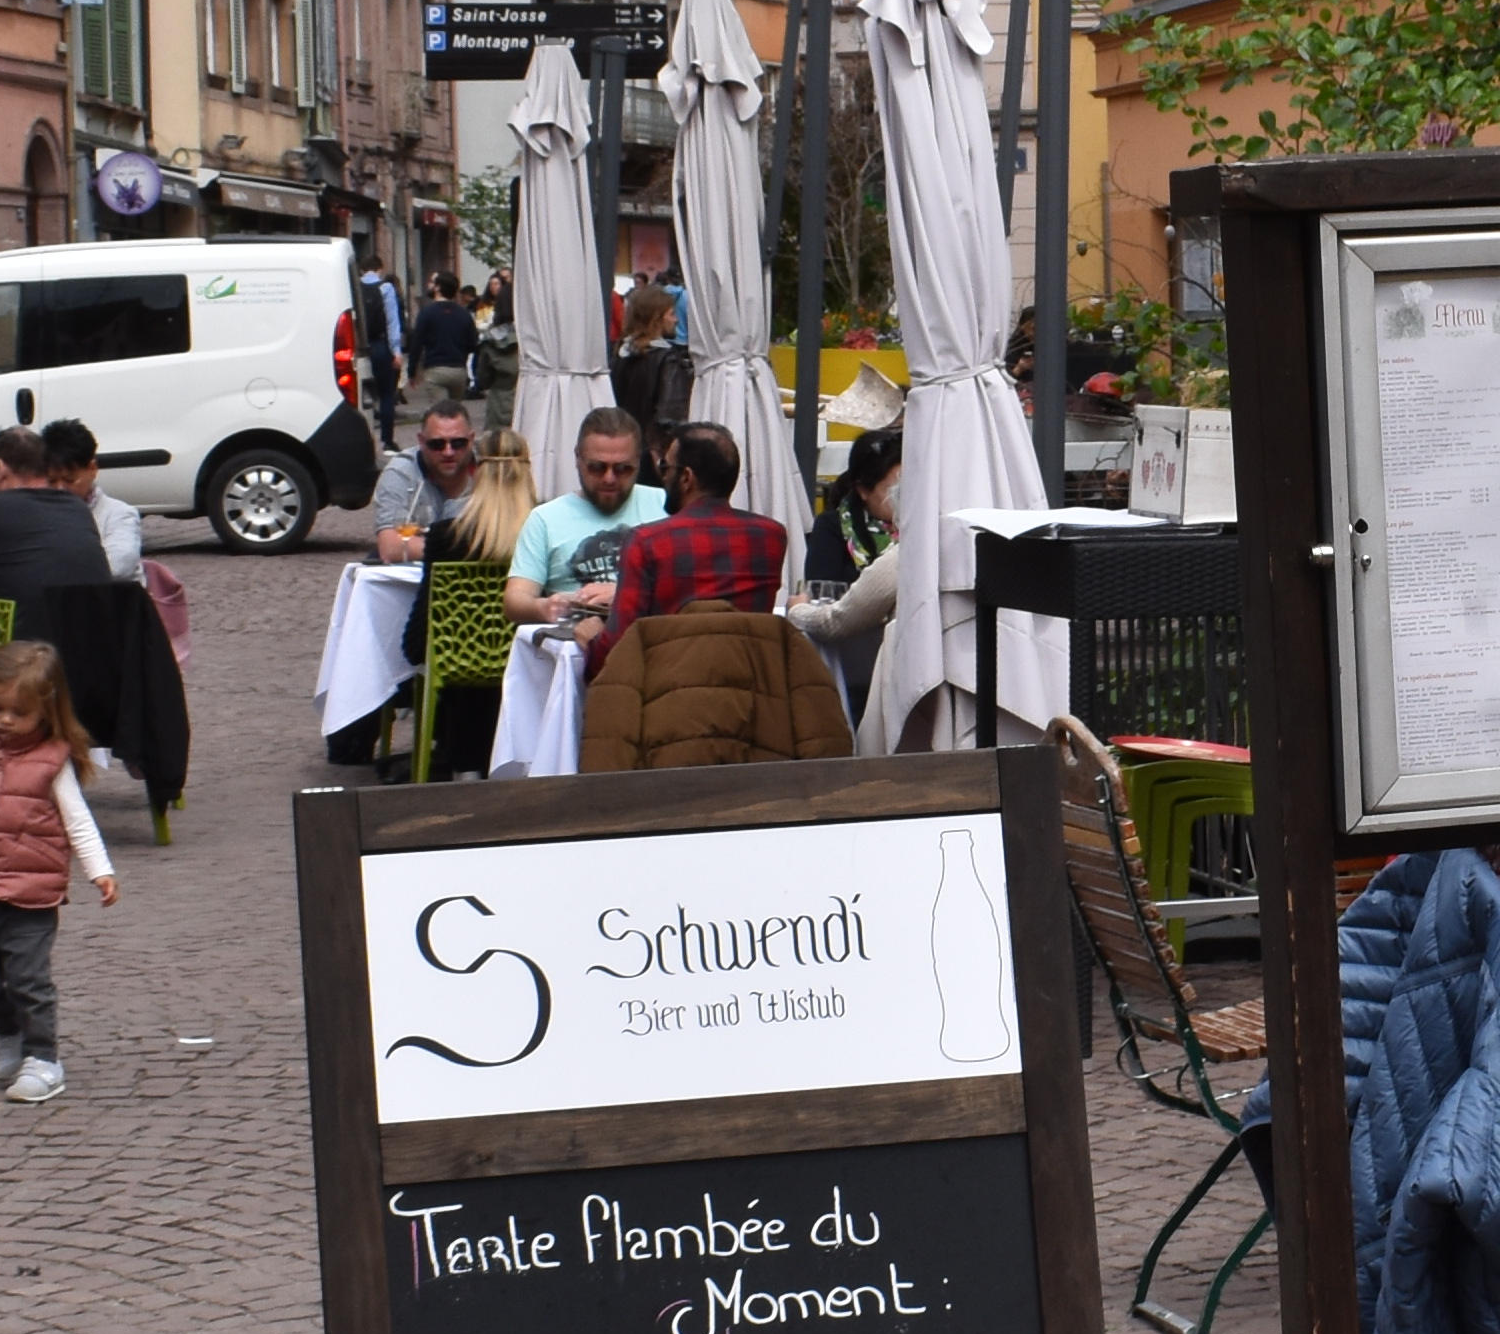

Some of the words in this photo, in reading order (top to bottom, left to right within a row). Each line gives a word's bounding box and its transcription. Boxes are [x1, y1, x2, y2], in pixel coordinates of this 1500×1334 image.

[452, 8, 547, 23] Saint-Josse
[453, 34, 528, 52] Montagne
[1432, 302, 1486, 331] Menu
[586, 893, 871, 978] Schwendi
[618, 997, 687, 1037] Bier
[697, 994, 741, 1029] und
[749, 986, 846, 1025] Wistub
[582, 1191, 791, 1265] flambée
[810, 1186, 880, 1250] du
